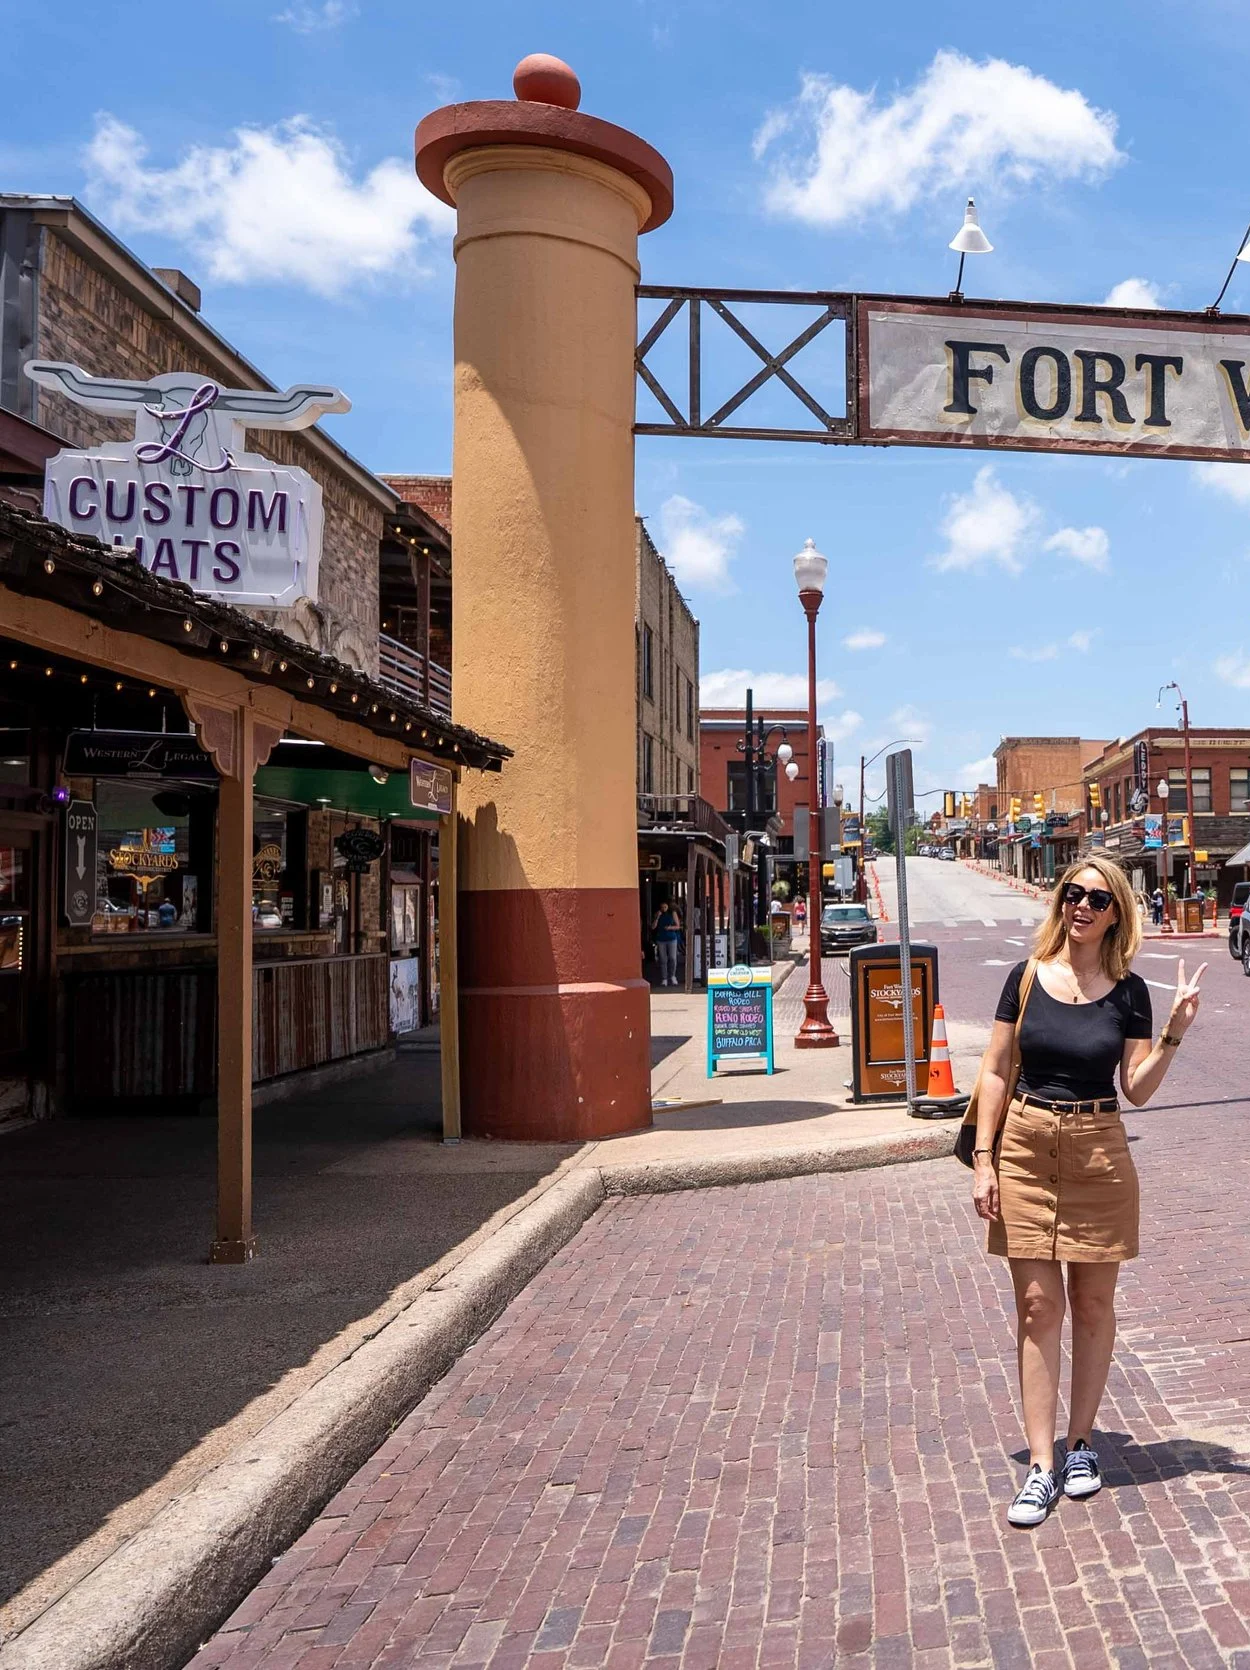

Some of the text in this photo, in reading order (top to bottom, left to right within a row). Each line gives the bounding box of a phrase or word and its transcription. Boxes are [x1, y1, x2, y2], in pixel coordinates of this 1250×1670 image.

[939, 340, 1184, 428] FORT
[67, 475, 288, 534] CUSTOM
[83, 747, 138, 759] WESTERN
[164, 751, 210, 762] LEGACY
[68, 815, 96, 831] OPEN
[109, 848, 179, 870] STOCKYARDS
[743, 990, 762, 998] BILL
[870, 987, 921, 998] STOCKYDS
[728, 997, 751, 1006] RODEO
[715, 1012, 764, 1024] RENO RODEO
